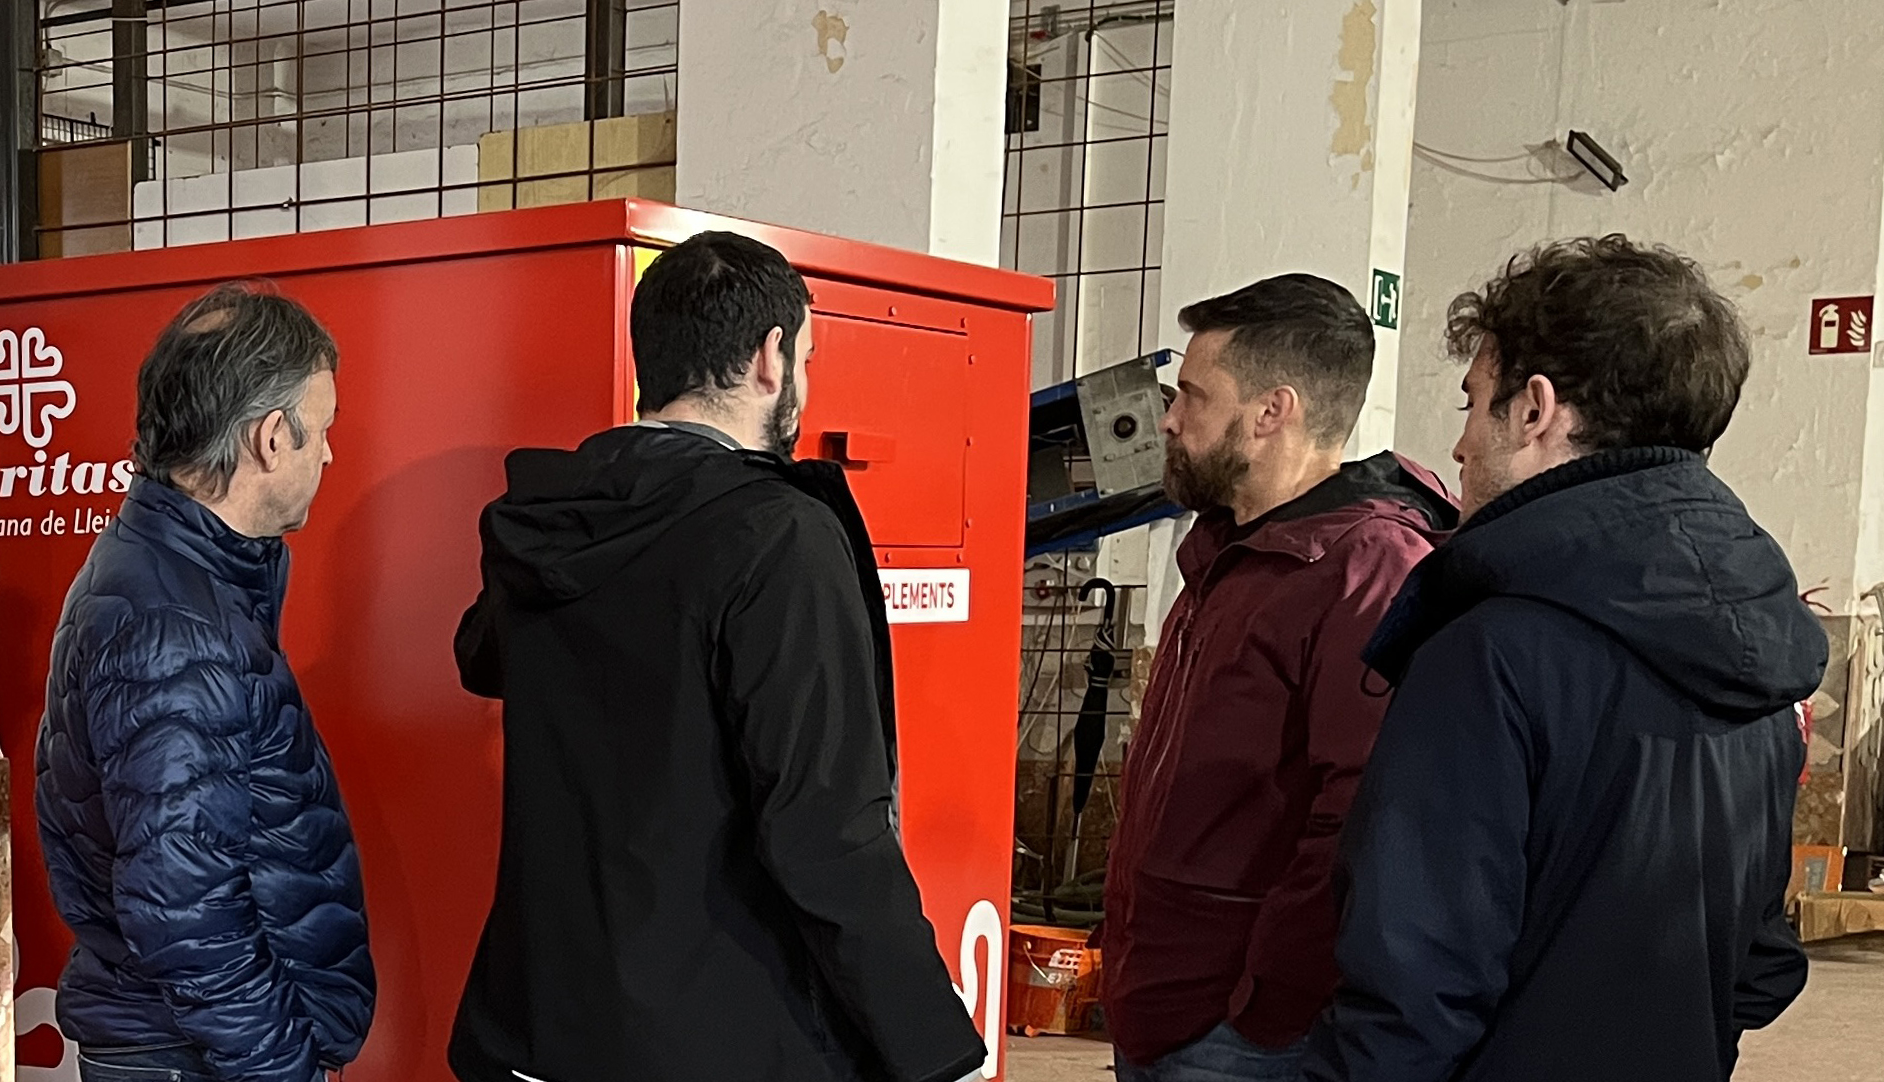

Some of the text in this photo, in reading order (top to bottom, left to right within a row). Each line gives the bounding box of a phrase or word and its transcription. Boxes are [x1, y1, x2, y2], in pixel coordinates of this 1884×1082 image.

[40, 509, 66, 536] de
[73, 508, 111, 535] Llei
[883, 582, 955, 609] PLEMENTS
